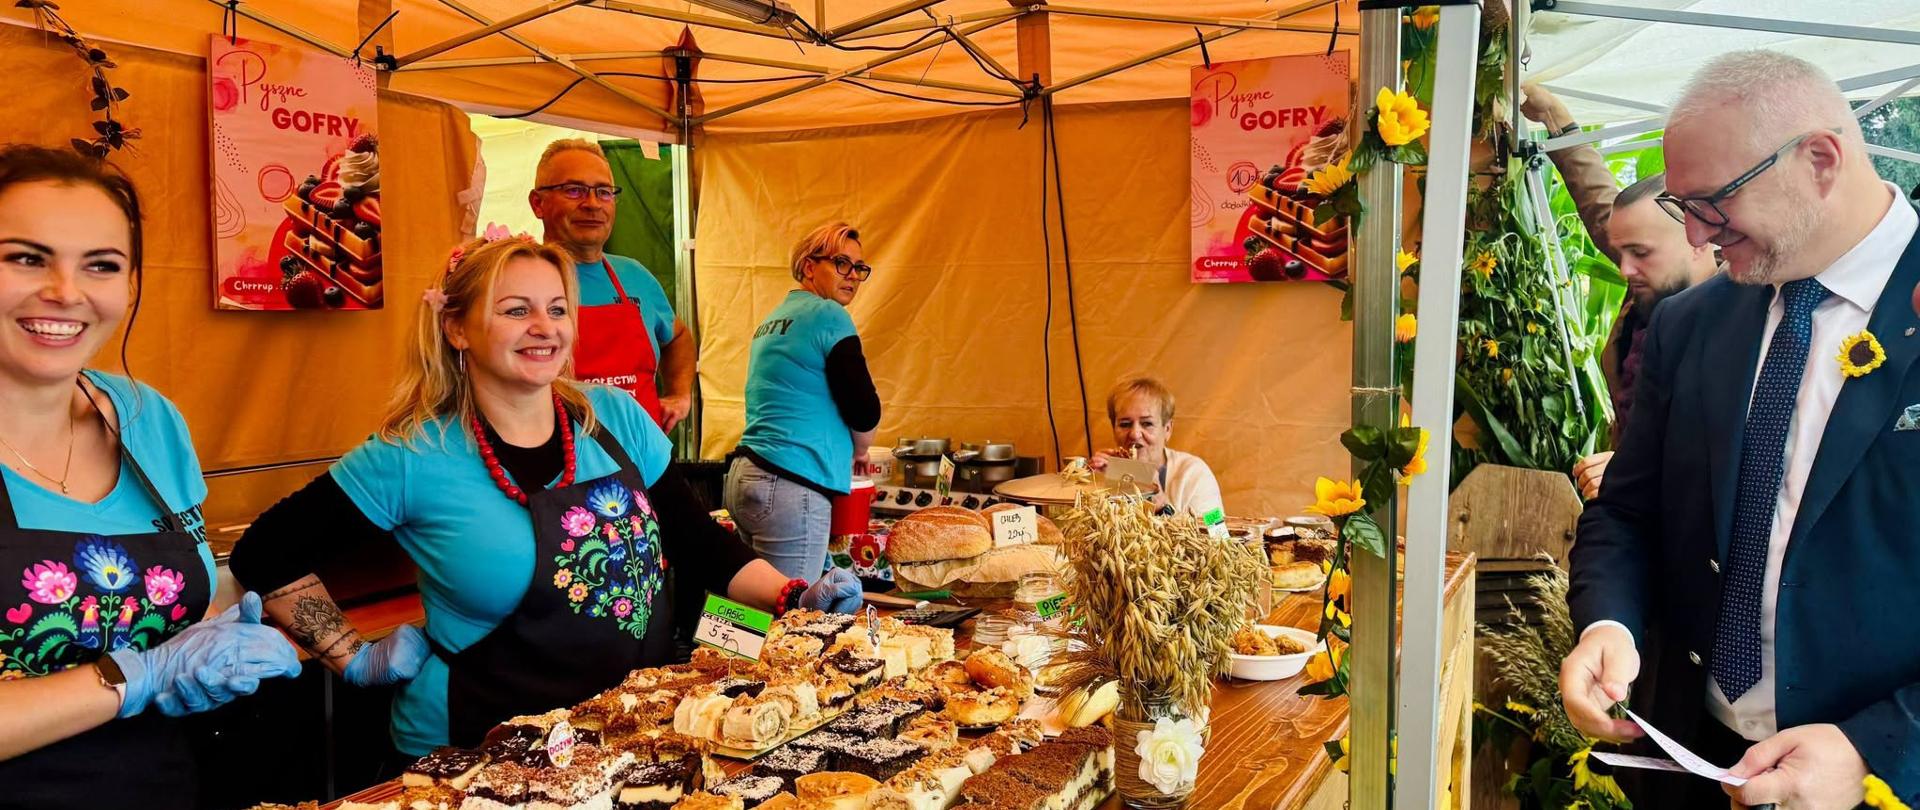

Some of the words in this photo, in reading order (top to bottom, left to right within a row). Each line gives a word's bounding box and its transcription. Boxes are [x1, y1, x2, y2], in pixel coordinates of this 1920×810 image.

[217, 51, 308, 111] Pyszne
[1195, 72, 1274, 119] Pyszne
[272, 107, 359, 138] GOFRY
[1240, 105, 1327, 131] GOFRY
